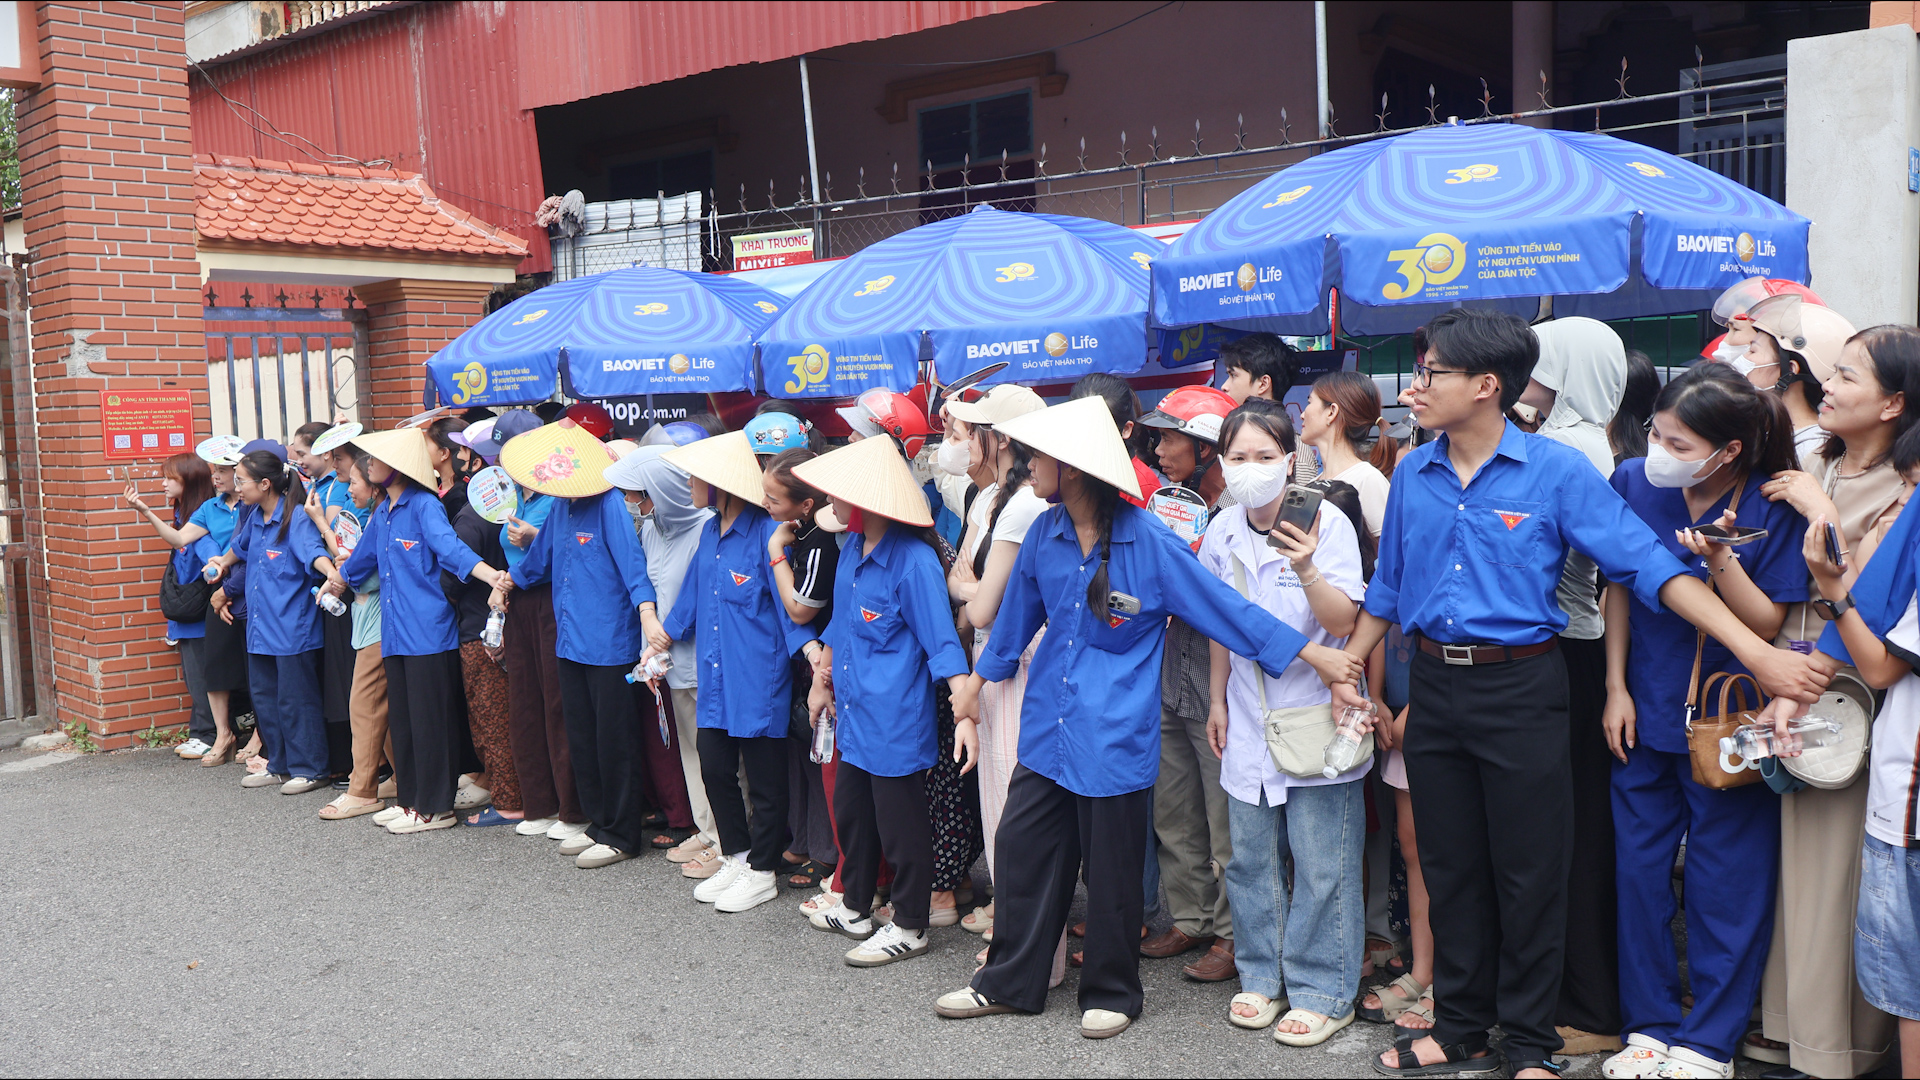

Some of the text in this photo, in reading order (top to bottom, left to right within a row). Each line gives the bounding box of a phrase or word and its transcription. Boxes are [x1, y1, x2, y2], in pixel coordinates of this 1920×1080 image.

[741, 240, 764, 252] KHAI
[1478, 242, 1562, 256] VỮNG TIN TIẾN VÀO
[1677, 234, 1776, 258] BAOVIET Life
[1382, 232, 1468, 300] 30
[1478, 253, 1580, 268] KỶ NGUYÊN VƯƠN MÌNH
[1720, 262, 1732, 272] BẢO
[1180, 266, 1282, 292] BAOVIET Life
[1478, 267, 1536, 279] CỦA DÂN TỘC
[1219, 295, 1232, 306] BẢO
[1232, 294, 1244, 304] VIỆT
[1262, 292, 1276, 302] THỌ
[966, 335, 1098, 359] BAOVIET Life
[602, 358, 716, 372] BAOVIET Life
[785, 344, 831, 394] 30
[1022, 360, 1038, 370] BẢO
[1038, 360, 1052, 368] VIỆT
[1054, 358, 1076, 366] NHÂN
[452, 362, 488, 405] 30
[1166, 501, 1180, 510] QUÉT
